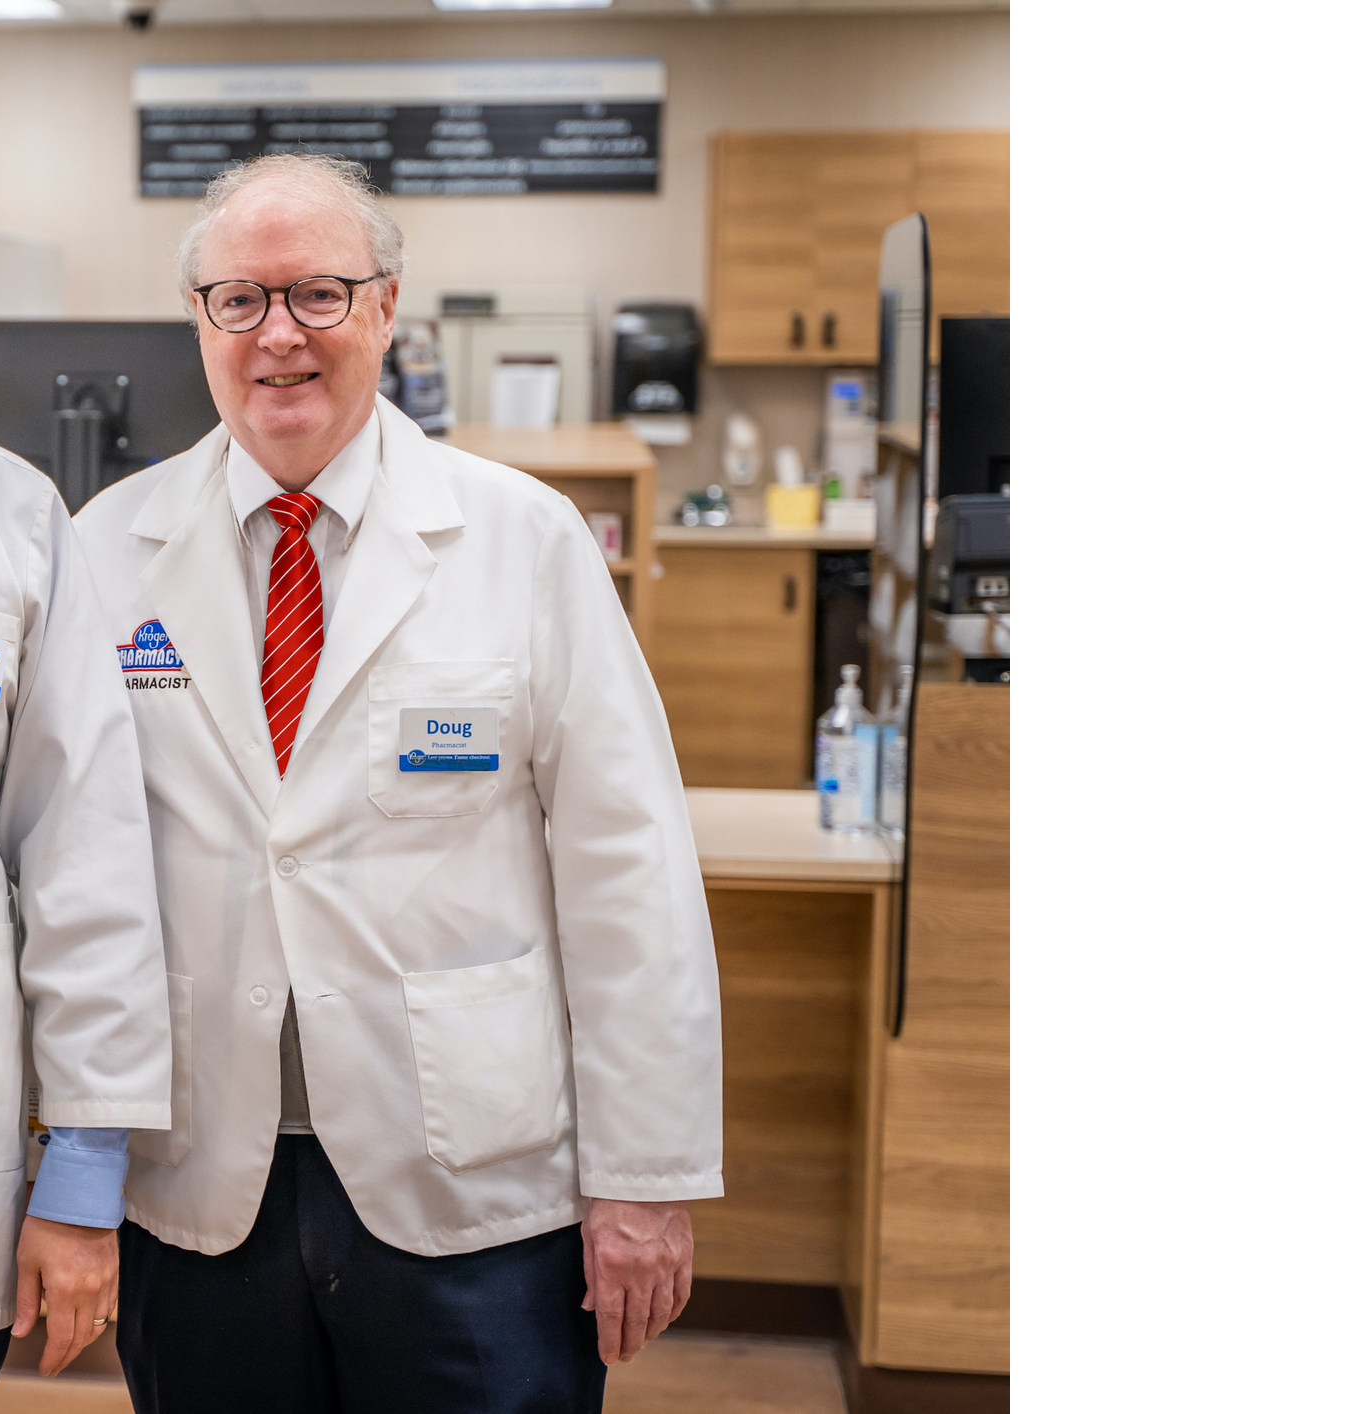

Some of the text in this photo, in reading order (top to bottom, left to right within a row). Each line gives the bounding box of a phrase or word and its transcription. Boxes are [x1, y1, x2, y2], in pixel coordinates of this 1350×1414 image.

[119, 649, 181, 666] HARMACY
[125, 677, 191, 690] ARMACIST
[427, 720, 472, 738] Doug
